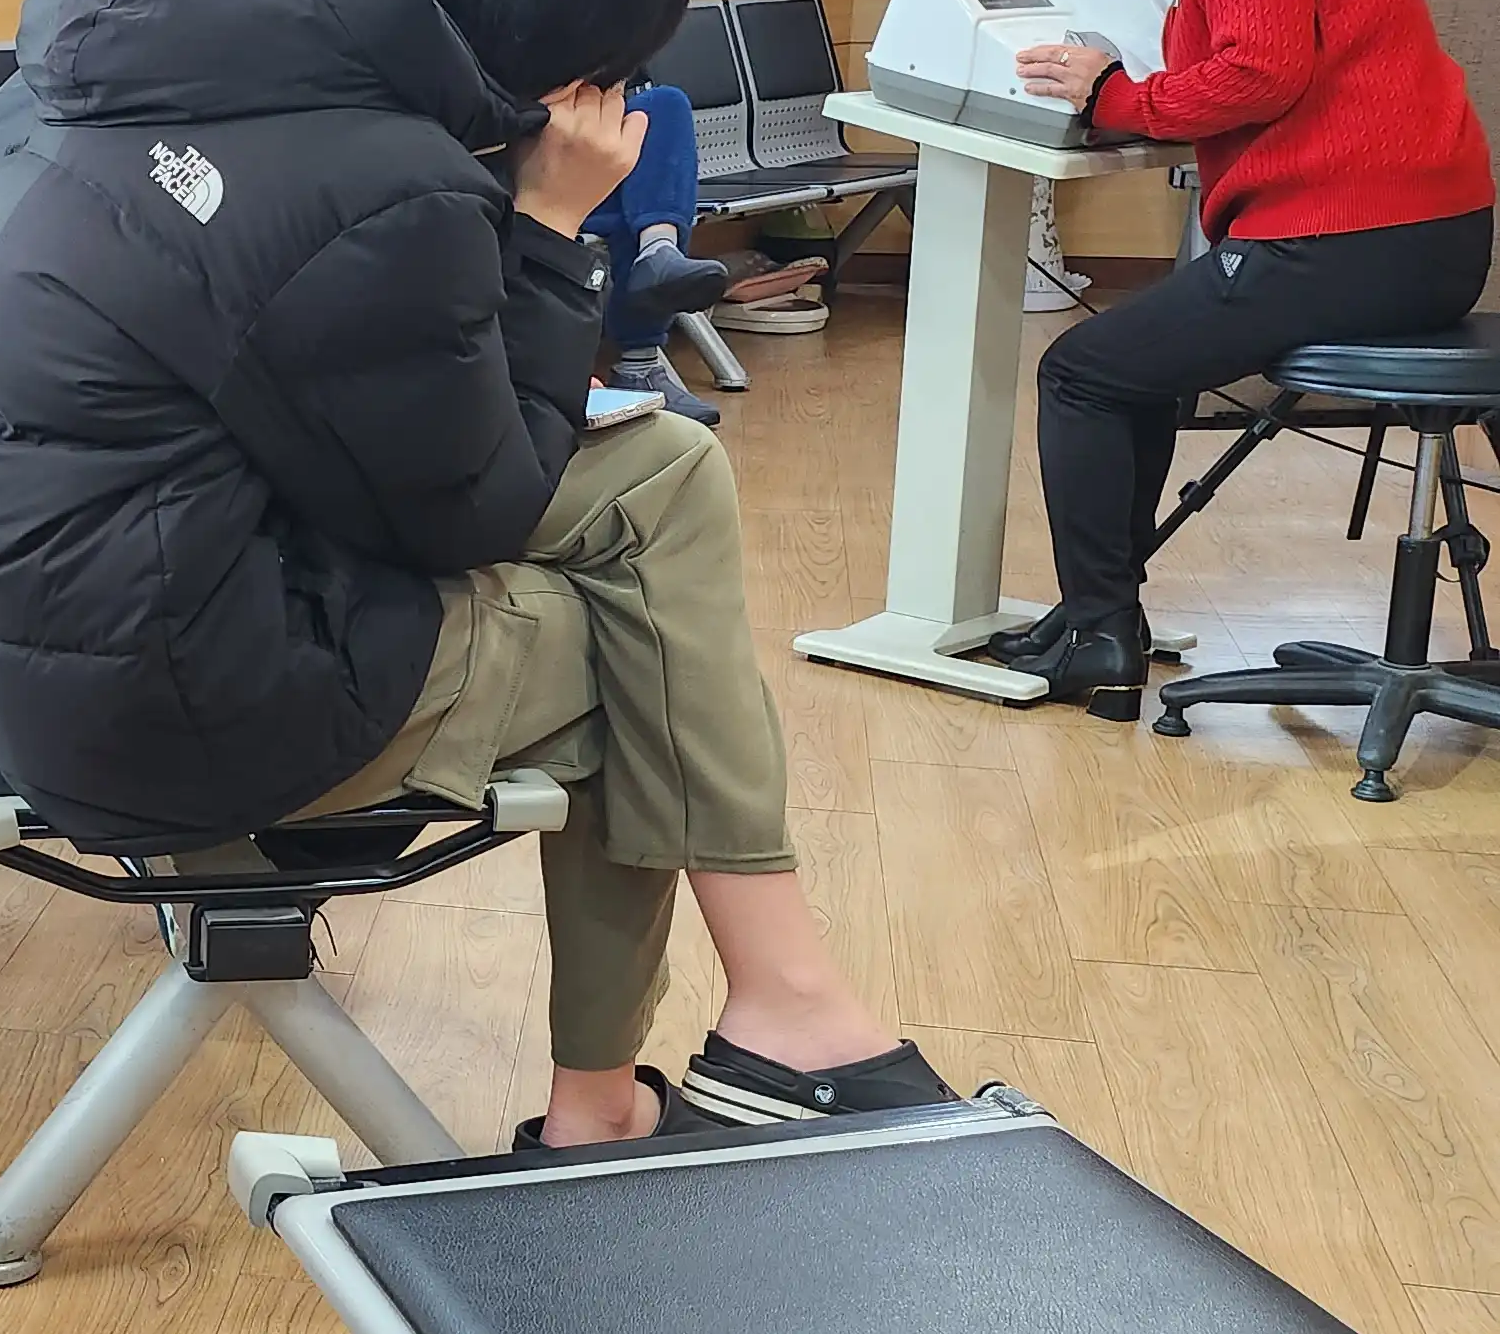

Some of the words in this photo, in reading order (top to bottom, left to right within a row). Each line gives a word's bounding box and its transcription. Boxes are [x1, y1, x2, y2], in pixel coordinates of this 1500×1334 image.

[148, 140, 201, 190] NORTH
[181, 145, 214, 180] THE
[149, 163, 191, 204] FACE
